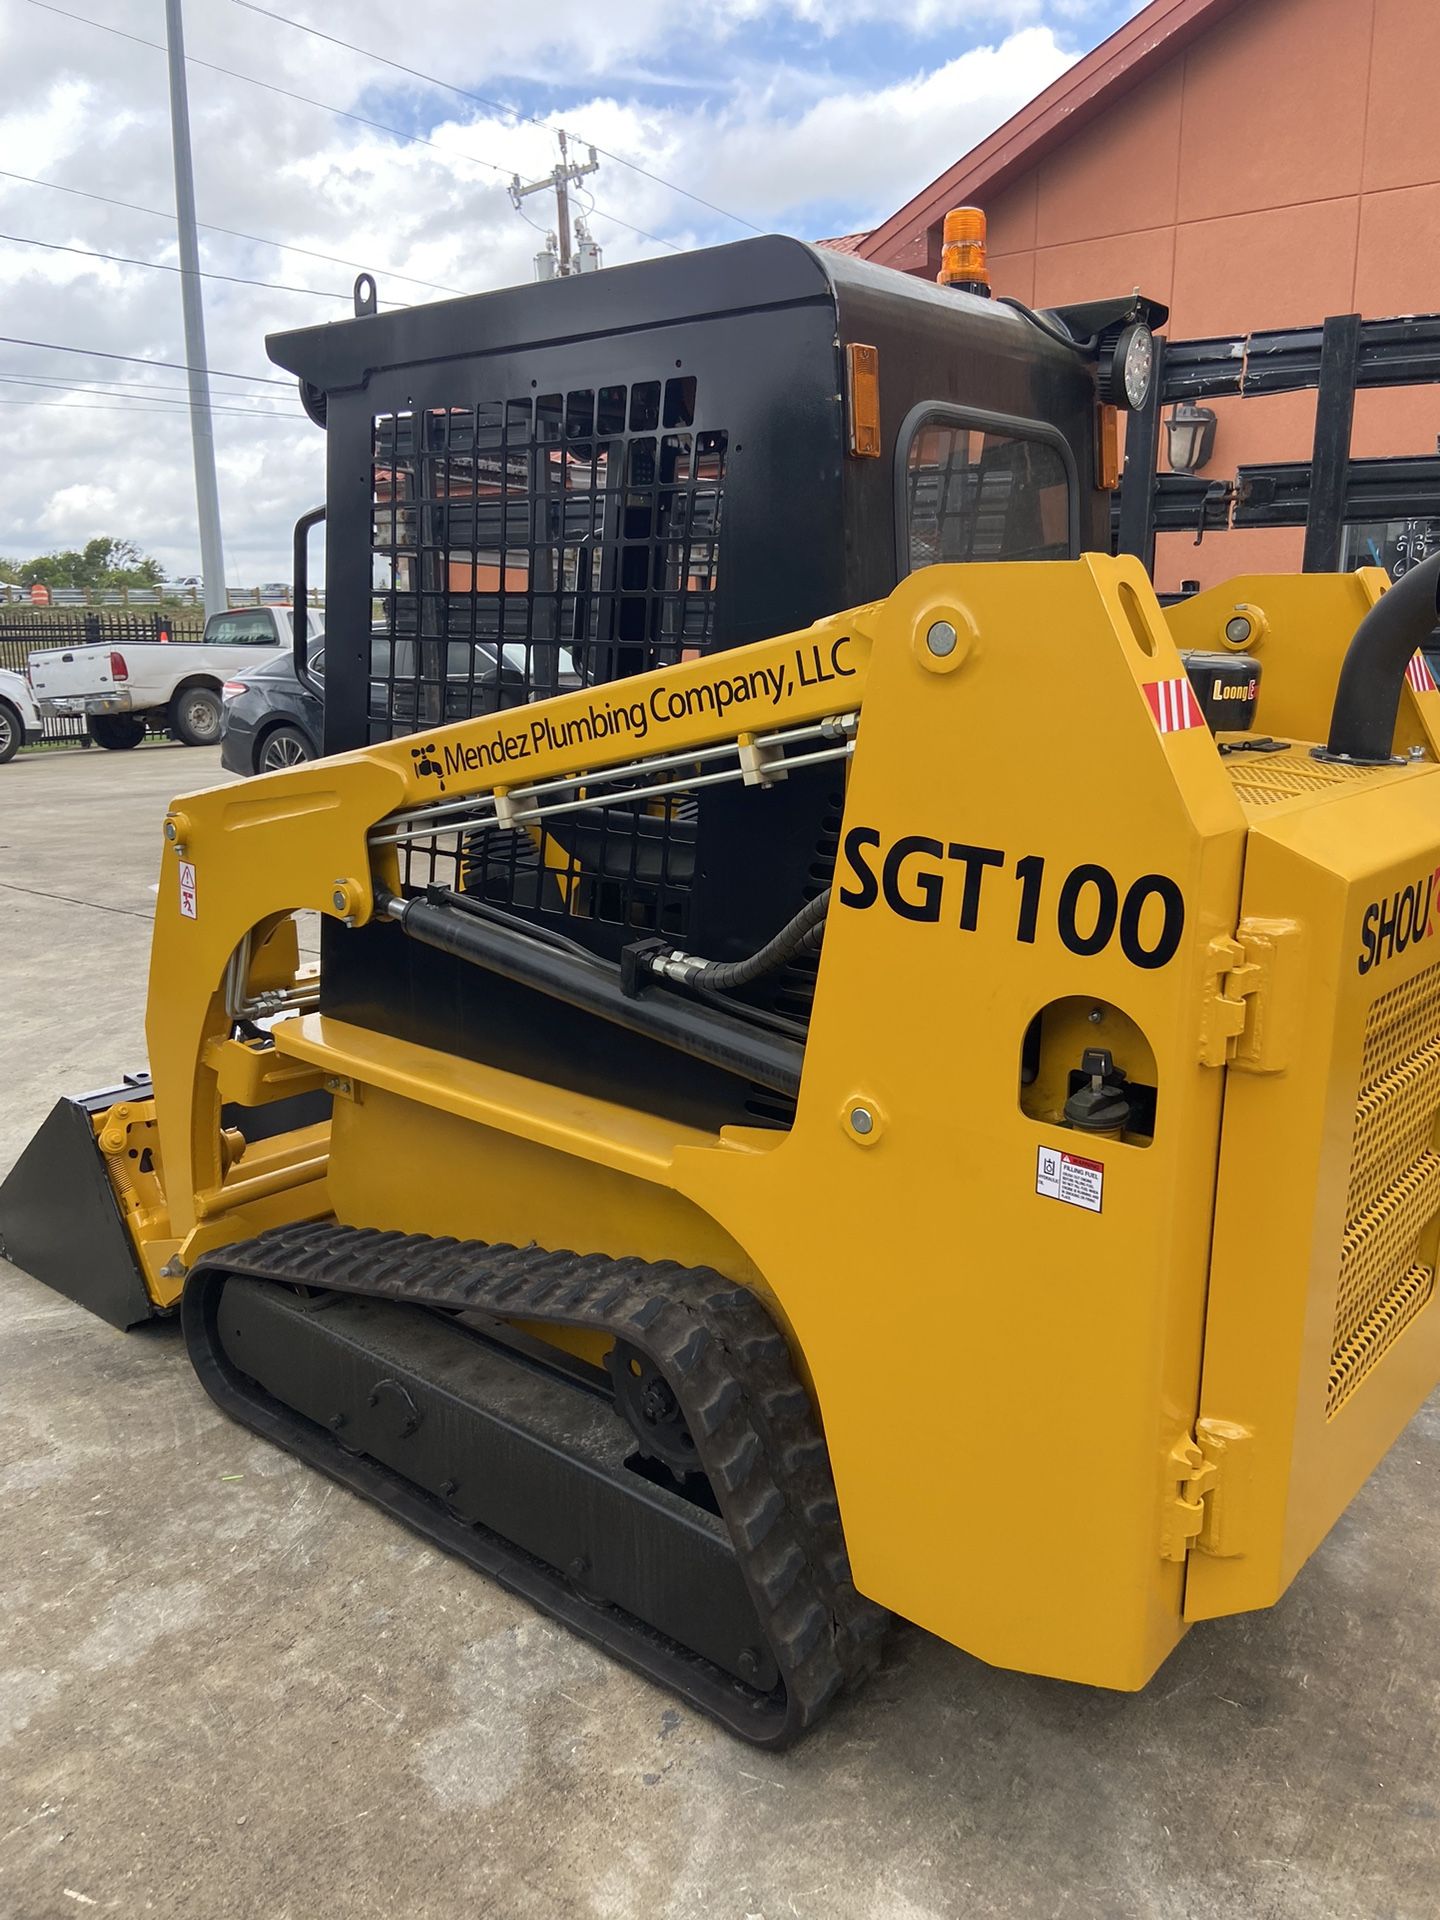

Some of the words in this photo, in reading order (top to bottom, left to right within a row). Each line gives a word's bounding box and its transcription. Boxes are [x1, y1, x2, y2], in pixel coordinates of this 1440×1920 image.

[444, 731, 531, 775] Mendez
[532, 703, 646, 755] Plumbing
[840, 826, 1185, 970] SGT100
[1063, 1164, 1084, 1175] FILLING
[1085, 1171, 1098, 1180] FUEL
